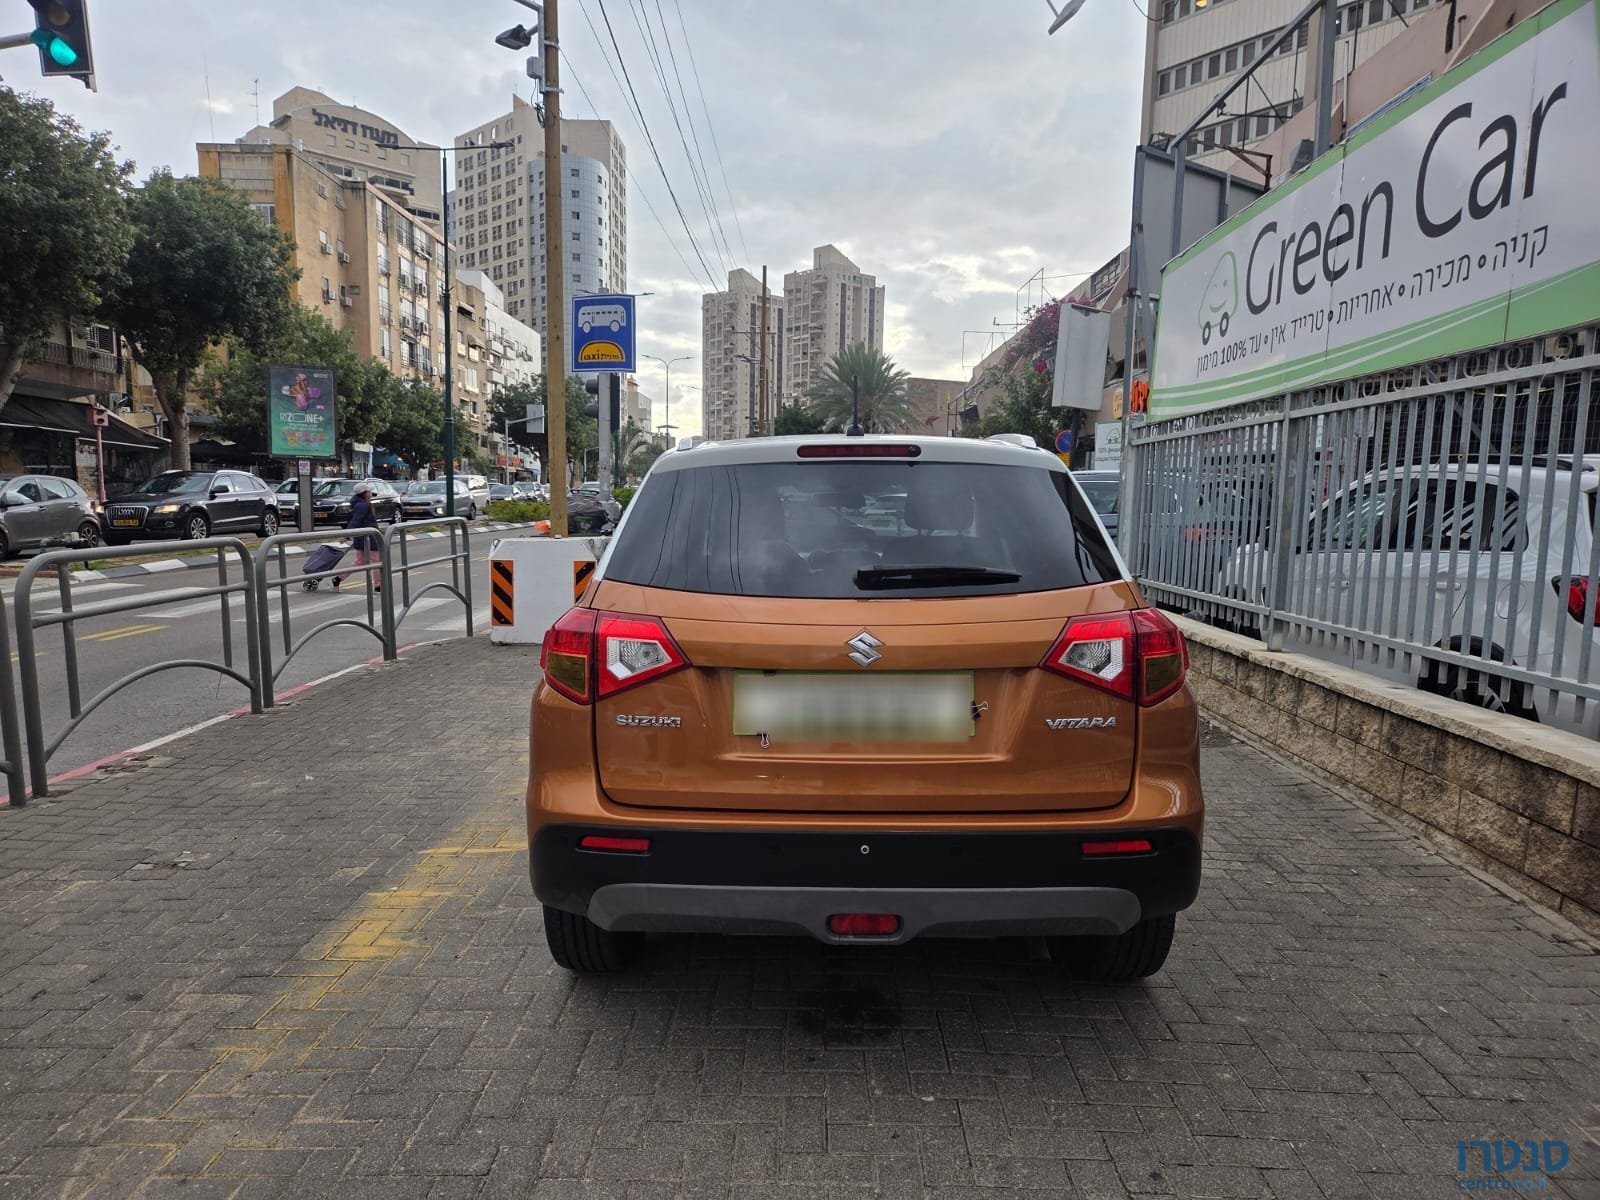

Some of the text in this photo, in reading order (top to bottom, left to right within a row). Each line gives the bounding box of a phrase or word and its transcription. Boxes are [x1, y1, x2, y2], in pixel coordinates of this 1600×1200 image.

[311, 108, 358, 135] דניאל
[1246, 81, 1568, 315] Green Car
[1196, 225, 1549, 378] קניה מכירה אחריות טרייד אין עד 100% מימון
[615, 714, 682, 728] SUZUKI
[1045, 716, 1117, 730] VITARA
